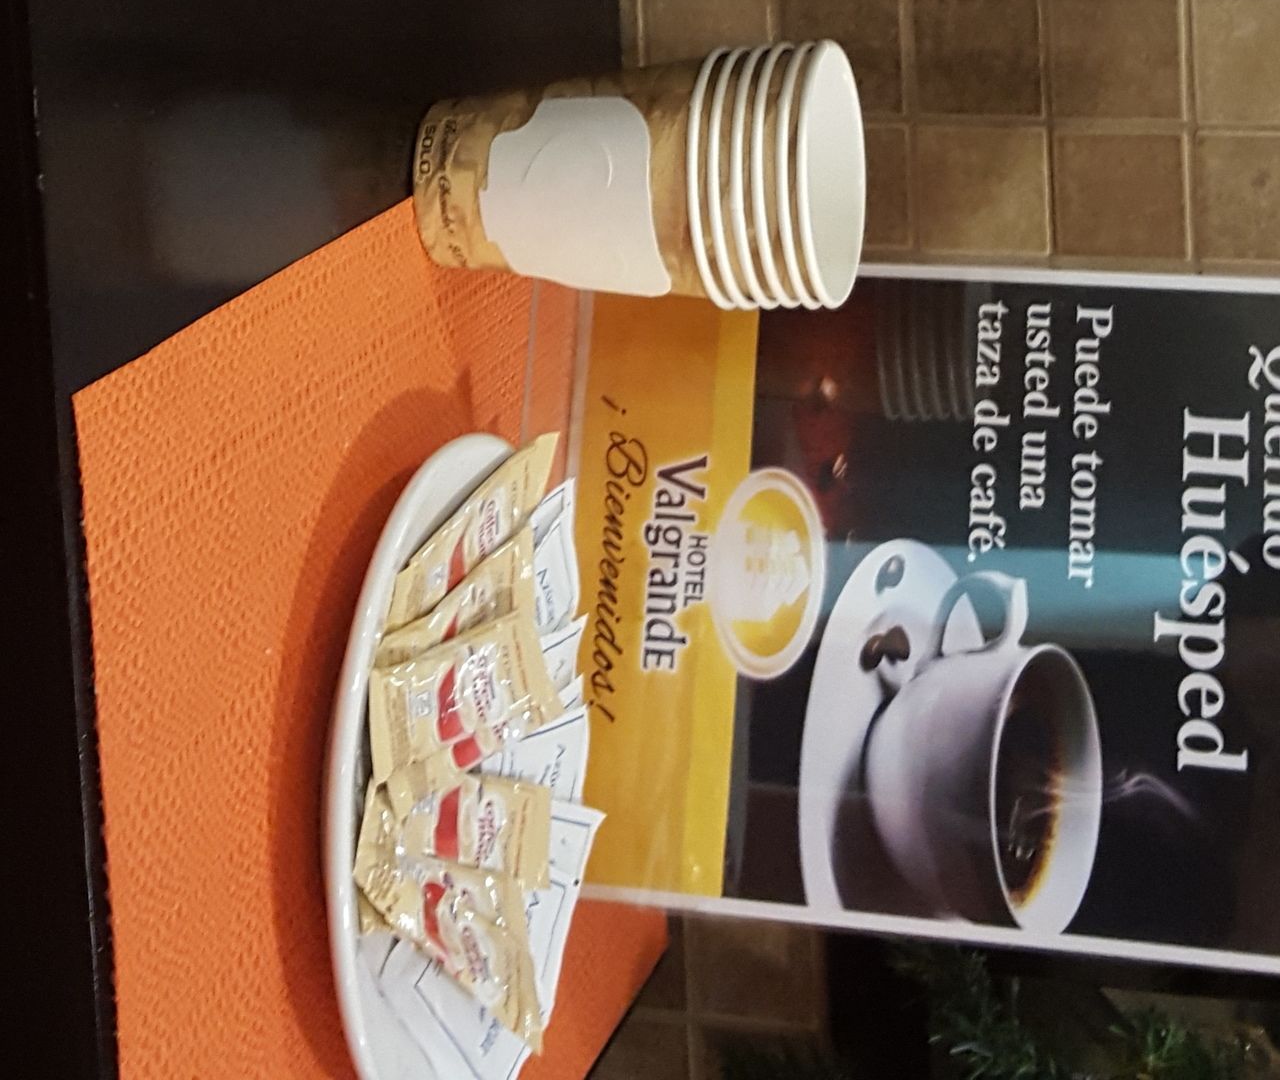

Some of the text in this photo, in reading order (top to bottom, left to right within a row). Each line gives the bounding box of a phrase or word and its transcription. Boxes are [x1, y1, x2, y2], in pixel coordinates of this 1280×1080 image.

[419, 124, 436, 176] SOLO
[967, 301, 1011, 563] taza de café.
[1019, 303, 1059, 510] usted una
[1067, 305, 1113, 588] Puede tomar
[683, 535, 708, 607] HOTEL
[1154, 406, 1251, 771] Huésped
